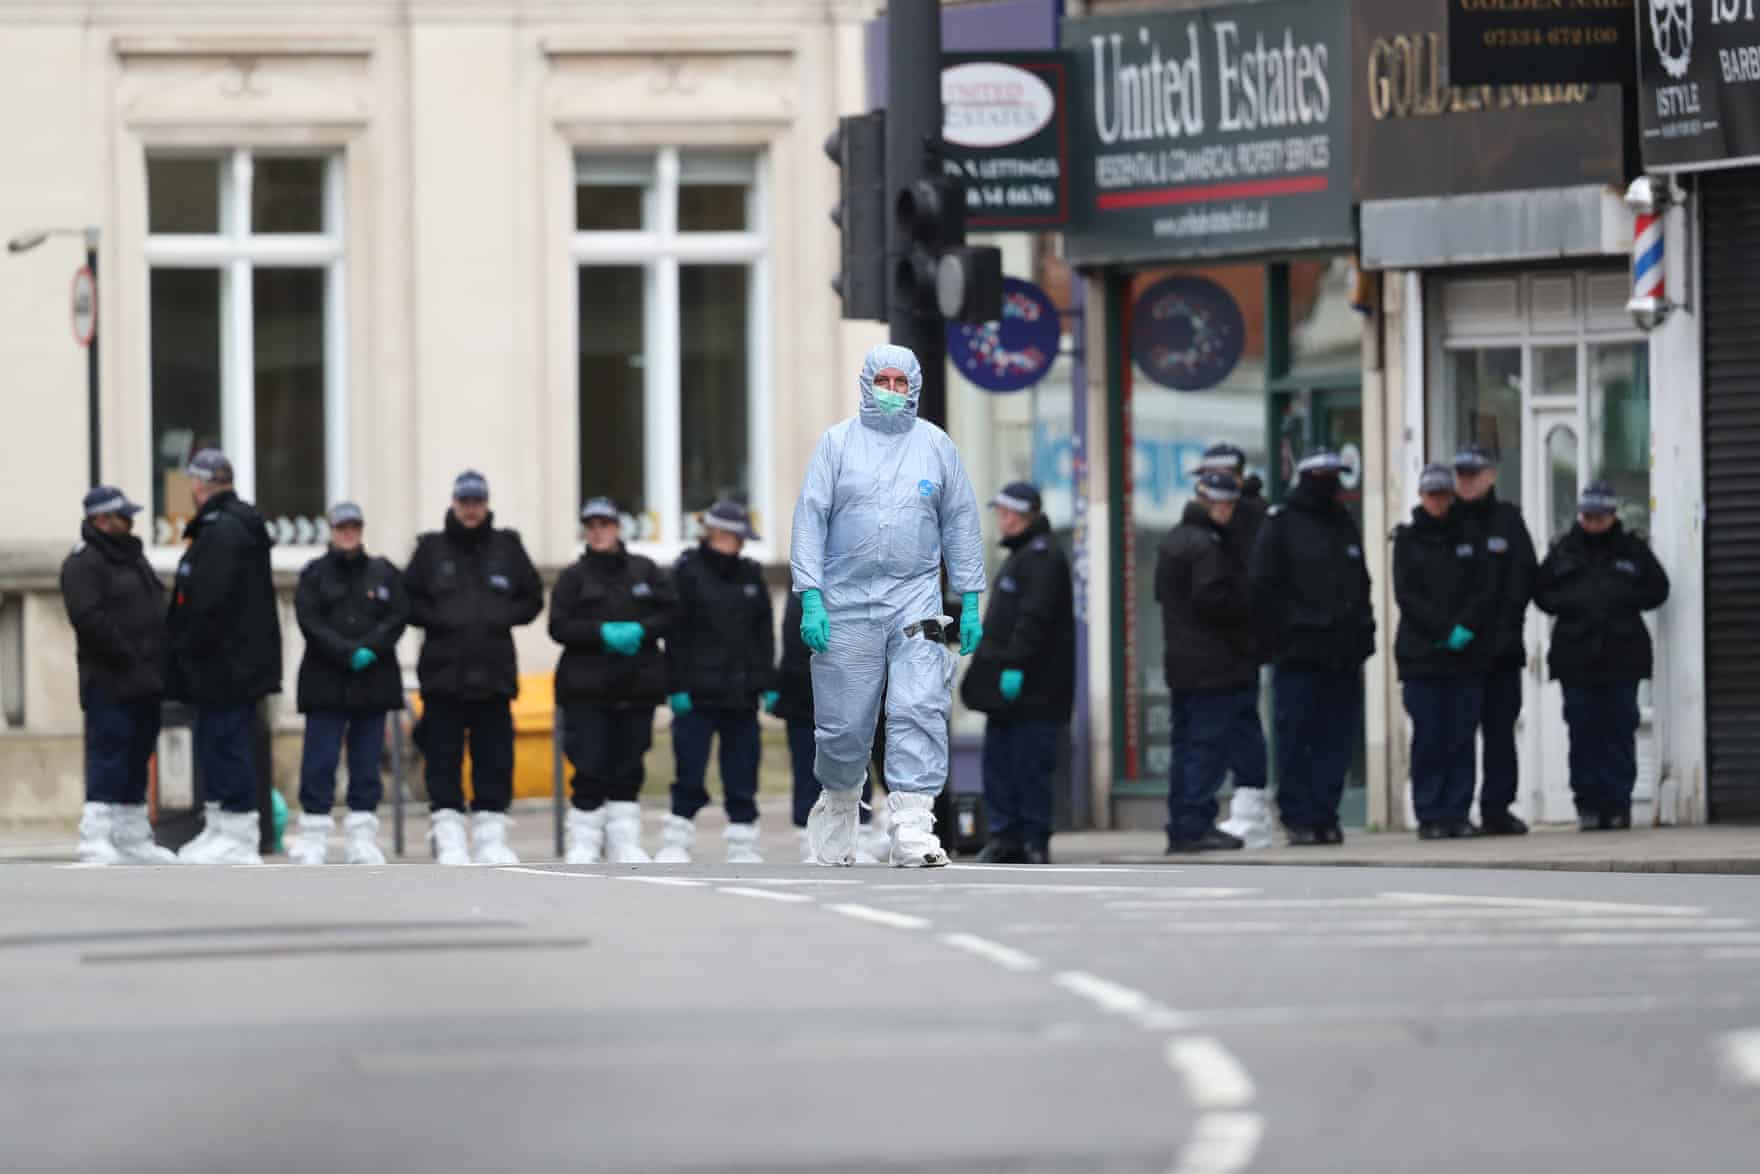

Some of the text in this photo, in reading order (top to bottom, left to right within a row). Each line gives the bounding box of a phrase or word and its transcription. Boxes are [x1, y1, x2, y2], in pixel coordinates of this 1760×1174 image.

[1091, 20, 1331, 144] United Estates
[1655, 83, 1701, 118] ISTYLE
